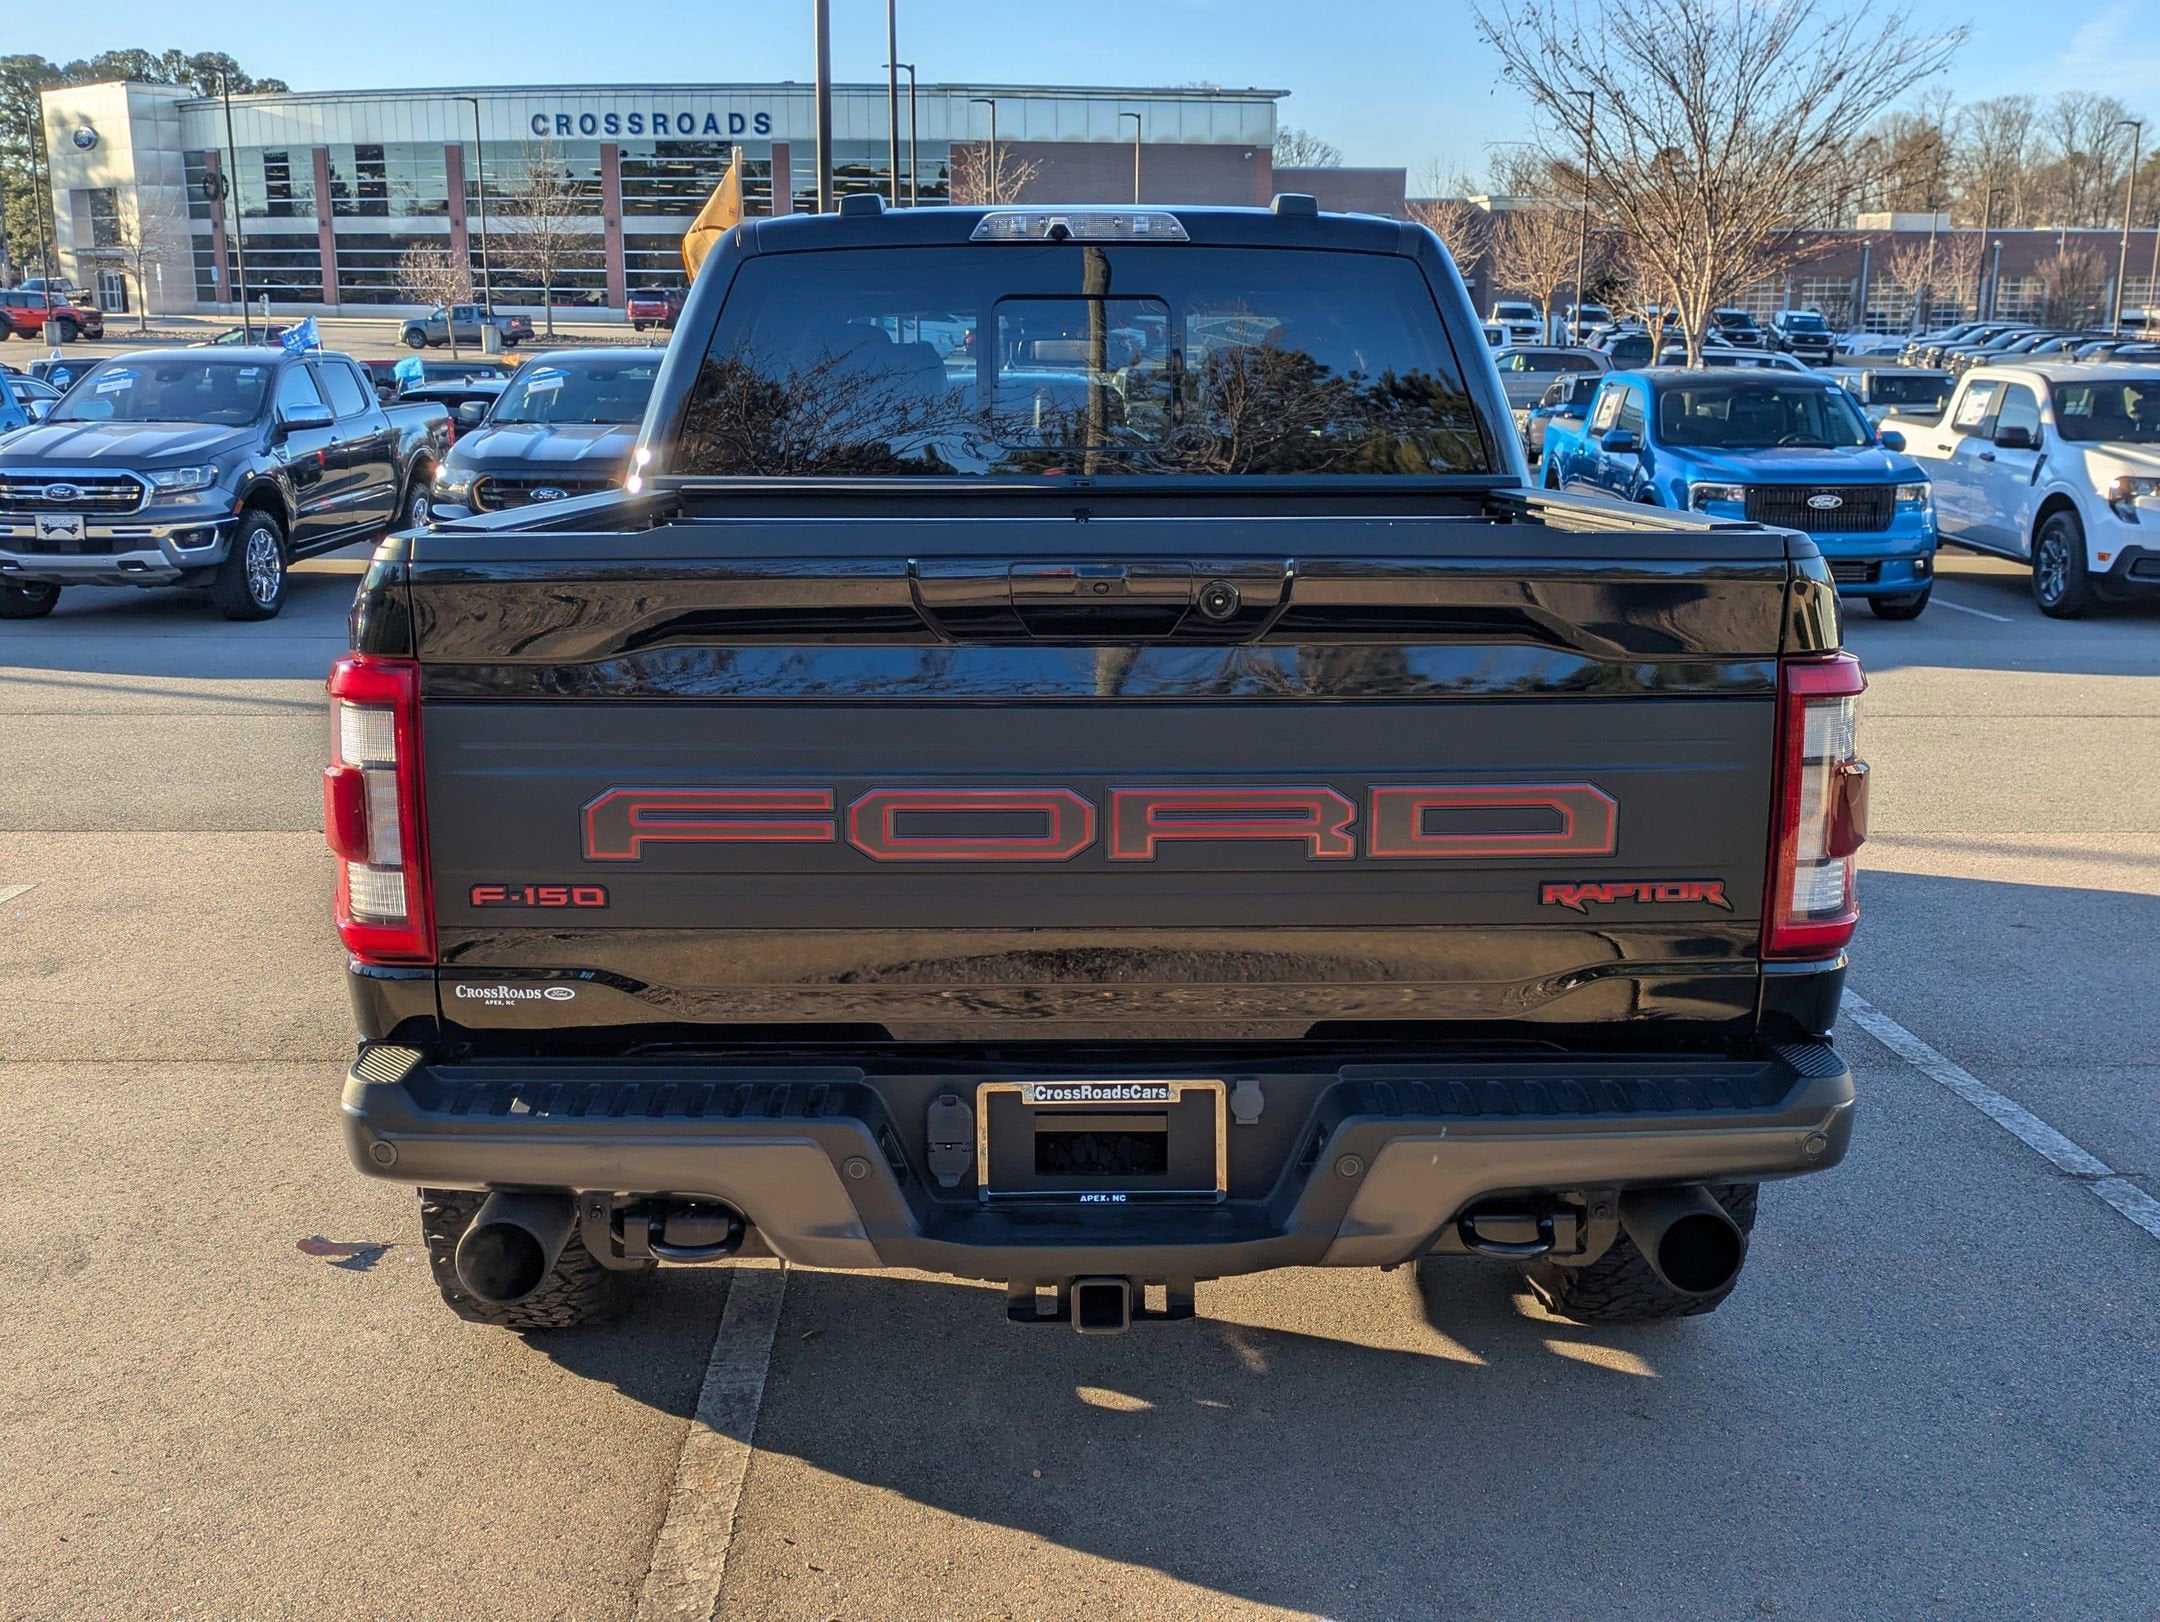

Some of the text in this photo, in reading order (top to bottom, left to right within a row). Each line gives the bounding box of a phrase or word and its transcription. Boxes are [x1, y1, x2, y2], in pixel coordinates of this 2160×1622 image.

[530, 112, 772, 136] CROSSROADS
[582, 786, 1616, 860] FORD
[471, 885, 607, 906] F-150
[1540, 879, 1733, 913] RAPTOR
[1035, 1085, 1167, 1100] CrossRoadsCars
[1111, 1194, 1127, 1202] NC
